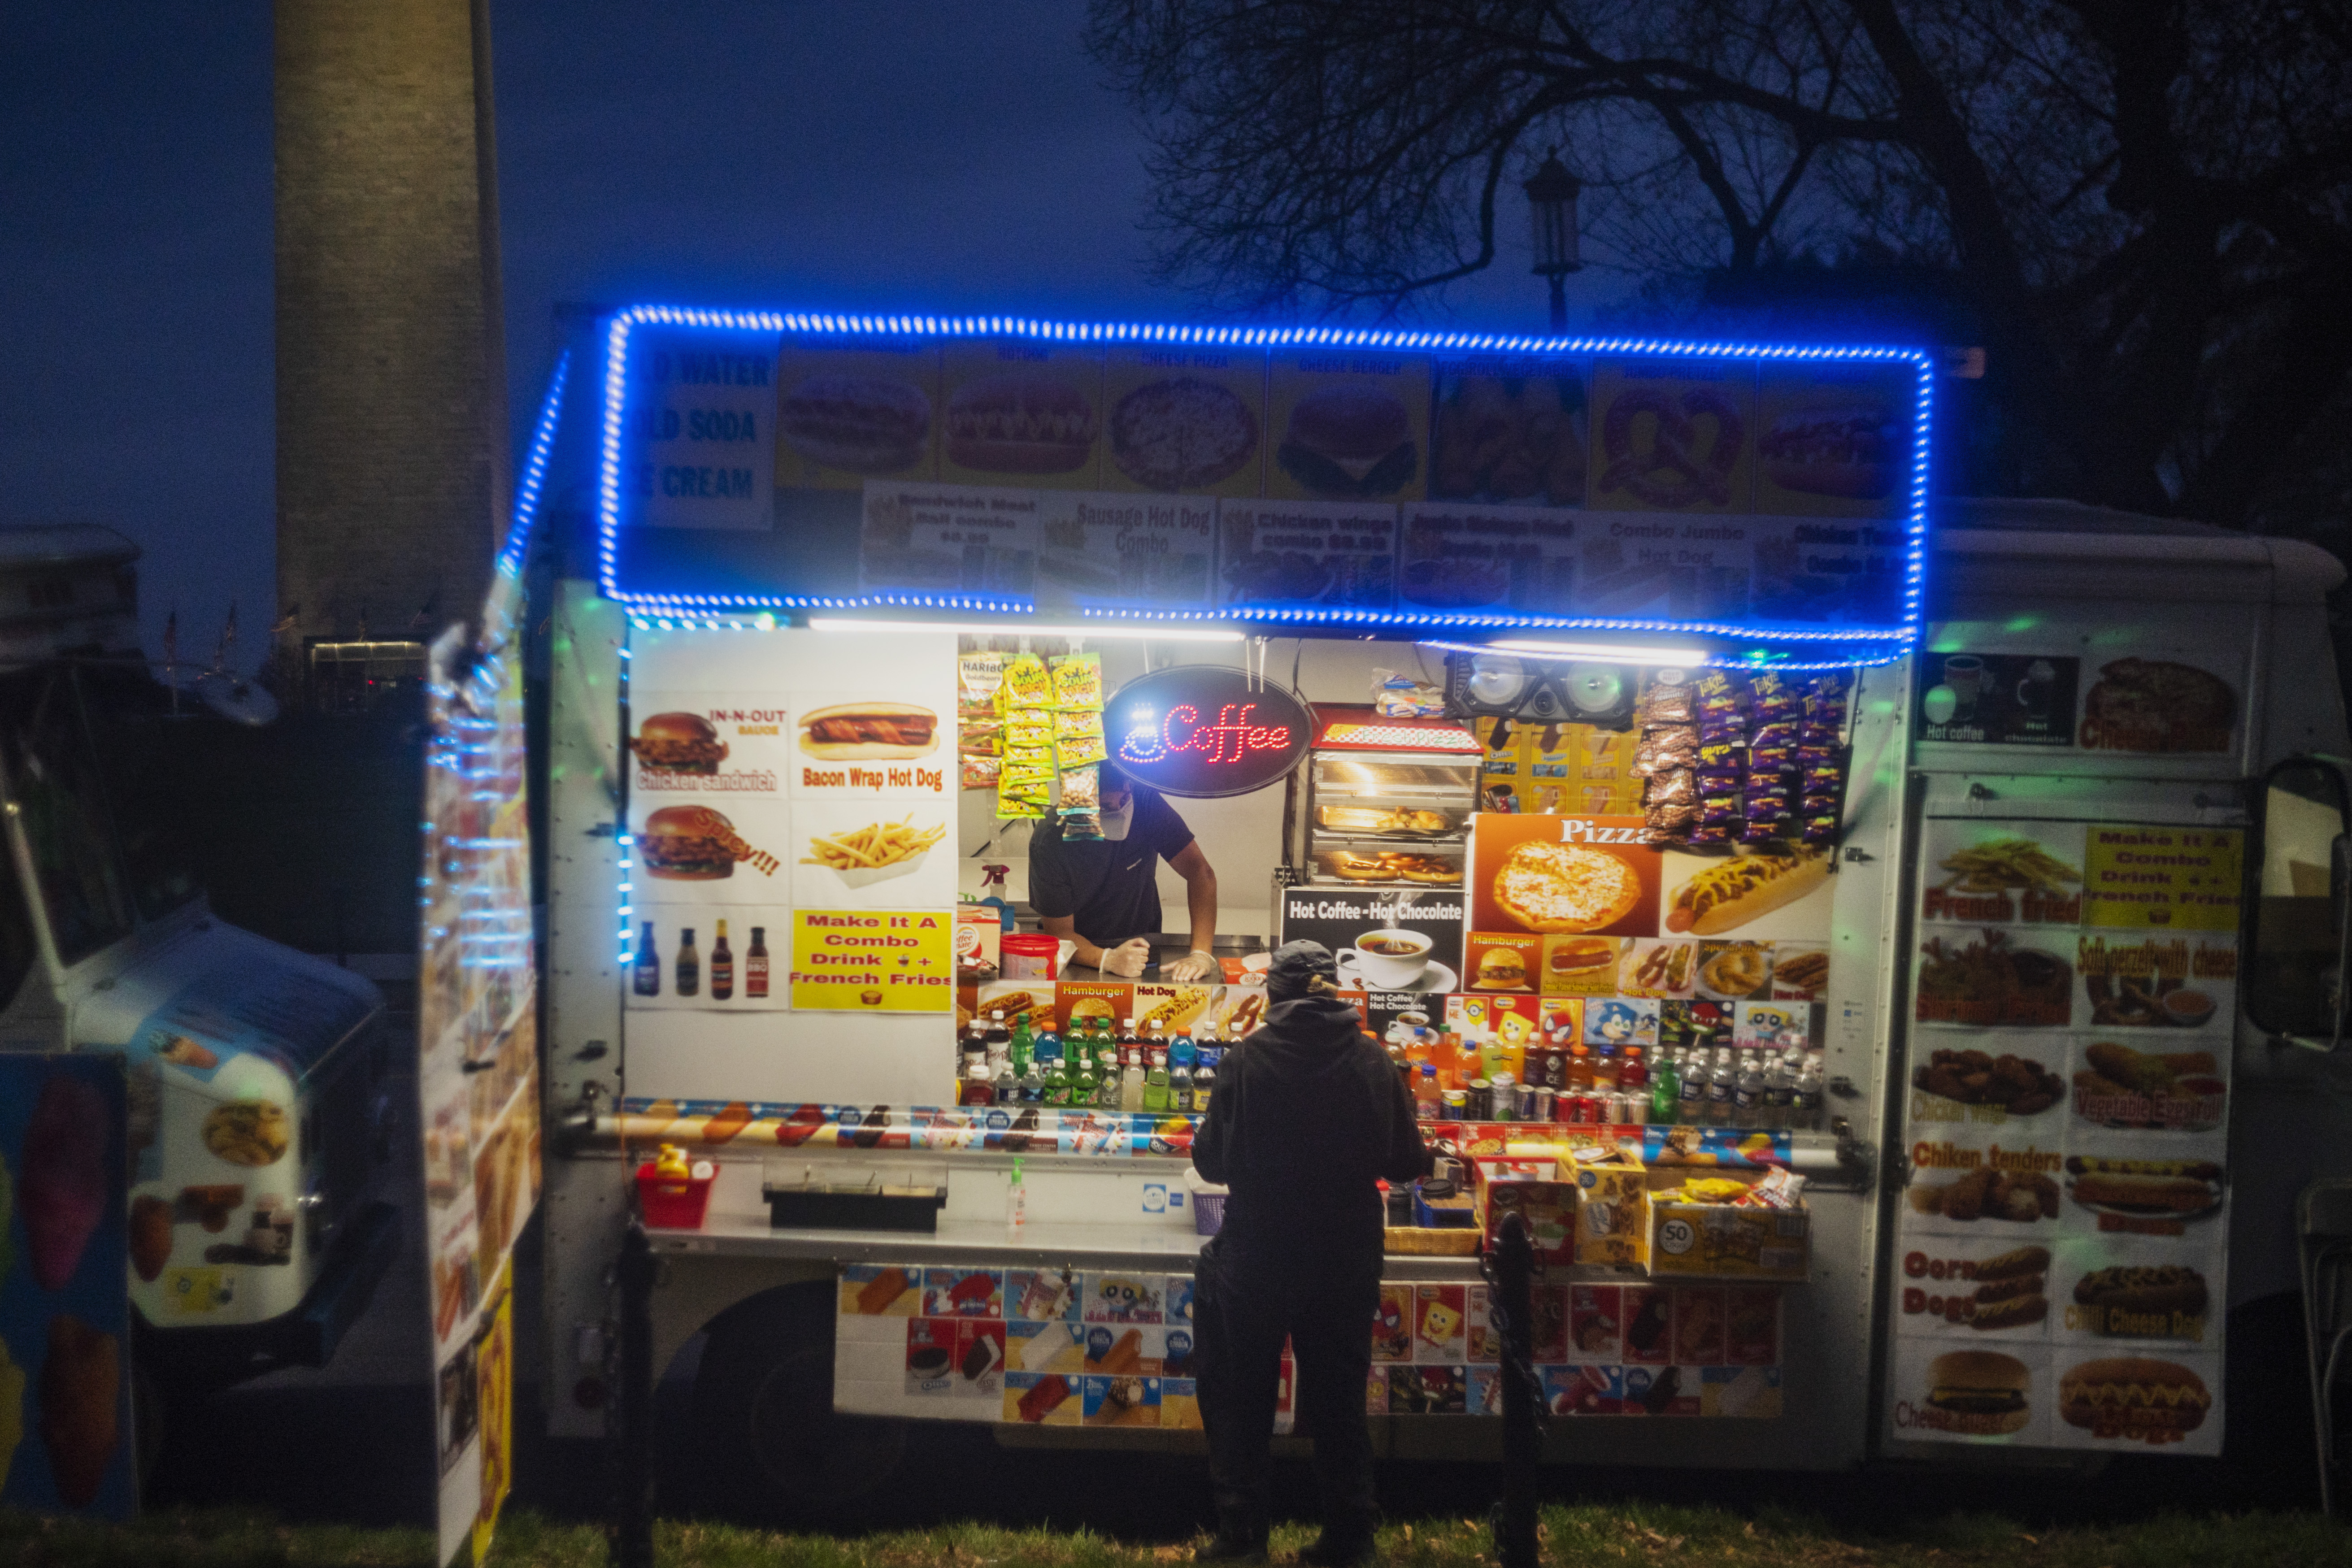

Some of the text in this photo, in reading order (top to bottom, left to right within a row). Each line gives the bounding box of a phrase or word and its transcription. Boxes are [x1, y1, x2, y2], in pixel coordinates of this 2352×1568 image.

[677, 353, 770, 387] WATER
[688, 410, 757, 442] SODA
[664, 466, 753, 499] CREAM
[1078, 503, 1210, 535] Sausage Hot Dog
[1258, 514, 1332, 530] Chicken
[1013, 673, 1044, 686] SOUR
[1061, 673, 1091, 687] SOUR
[709, 710, 786, 722] IN-N-OUT
[1163, 703, 1291, 763] Coffee
[1362, 729, 1468, 746] Fresh Pizza
[636, 770, 777, 791] Chicken sandwich
[803, 768, 943, 792] Bacon Wrap Hot Dog
[2099, 832, 2173, 847] Make
[2116, 851, 2211, 867] Combo
[2101, 870, 2172, 885] Drink
[1290, 901, 1316, 919] Hot
[1318, 901, 1361, 919] Coffee
[1370, 902, 1395, 920] Hot
[1397, 902, 1462, 920] Chocolate
[807, 915, 938, 929] Make It A
[825, 934, 919, 947] Combo
[1473, 935, 1535, 947] Hamburger
[810, 954, 882, 966] Drink
[790, 972, 951, 986] French Fries
[1063, 986, 1125, 997] Hamburger
[1137, 986, 1176, 998] Hot Dog
[1370, 994, 1413, 1003] Hot Coffee
[1624, 988, 1642, 996] Hot
[1448, 1010, 1460, 1020] ME
[1102, 1095, 1117, 1105] ICE
[1913, 1142, 1981, 1168] Chiken
[1665, 1225, 1687, 1241] 50
[1904, 1251, 1974, 1279] Corn
[1903, 1288, 1975, 1323] Dogs
[2110, 1307, 2167, 1334] Cheese
[2173, 1309, 2203, 1342] Dog
[1896, 1401, 1952, 1428] Cheese
